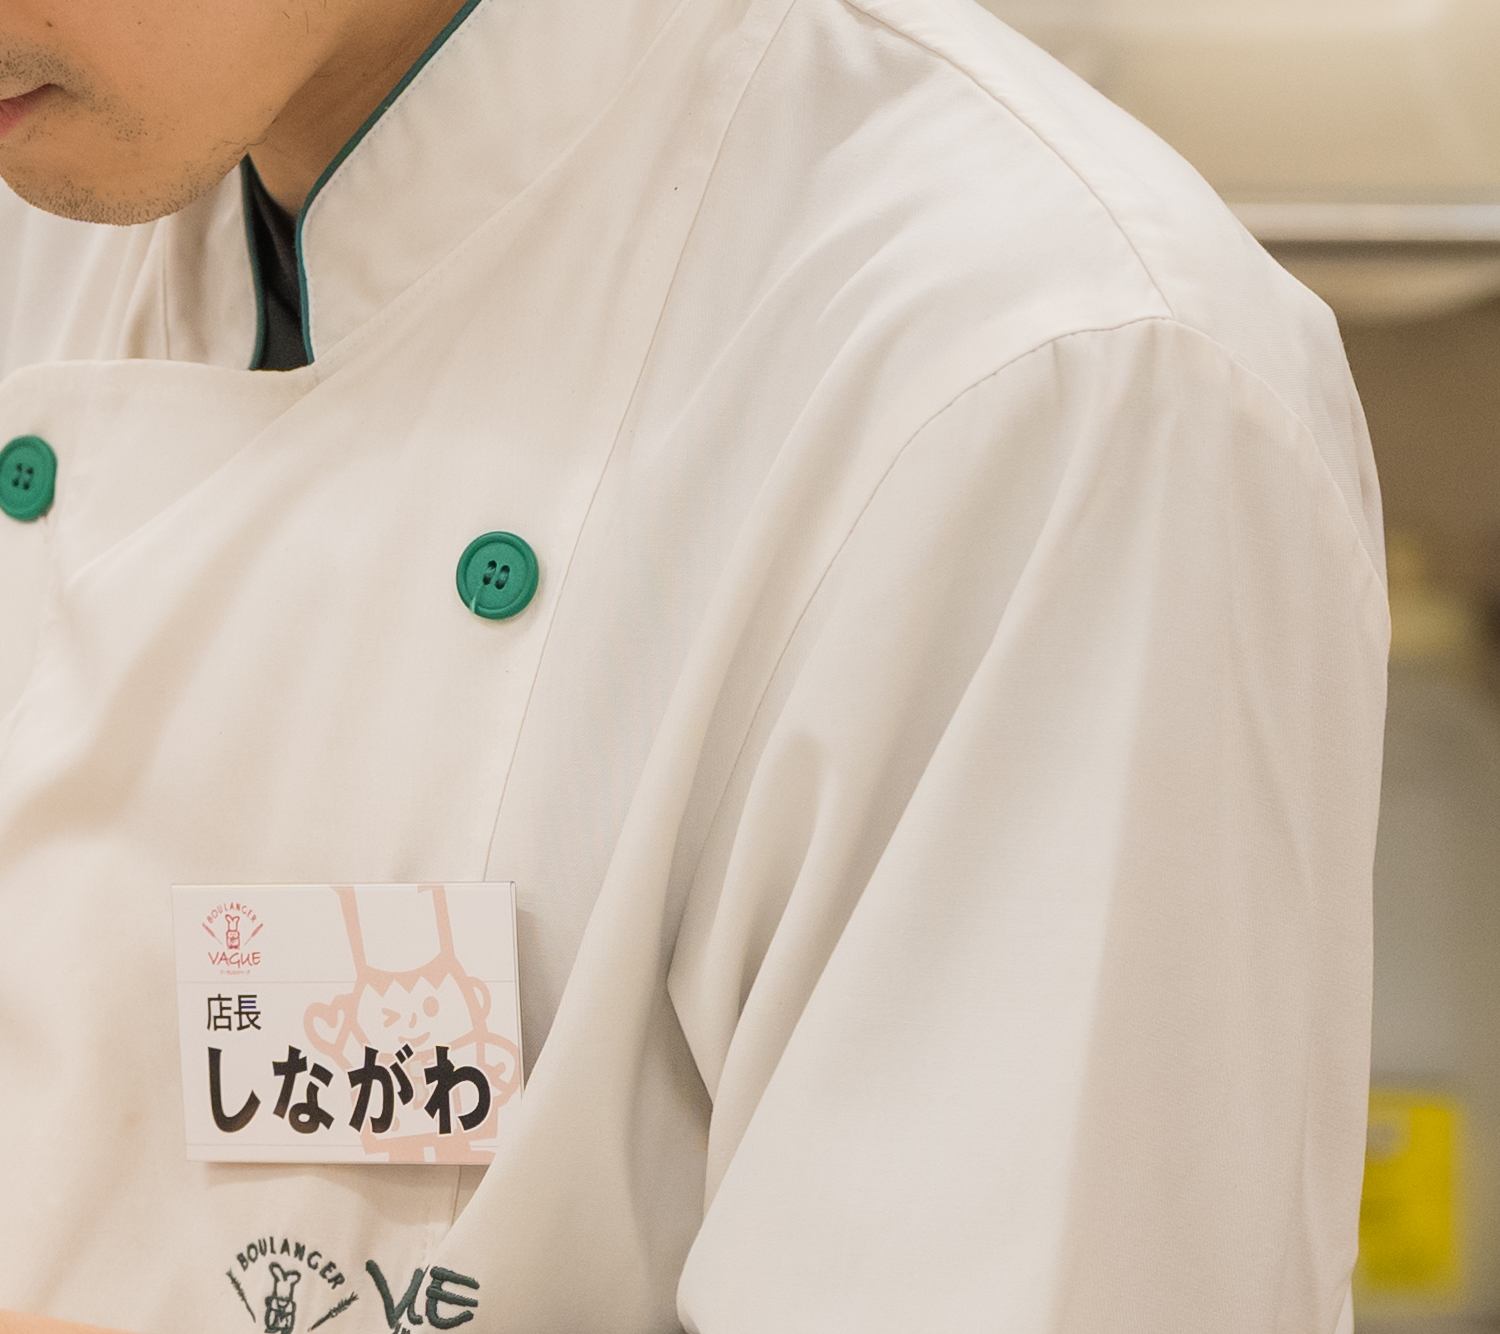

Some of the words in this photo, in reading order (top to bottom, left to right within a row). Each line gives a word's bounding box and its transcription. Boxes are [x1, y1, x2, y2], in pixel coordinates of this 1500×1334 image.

[206, 902, 257, 924] BOULANGER
[207, 951, 261, 968] VAGUE
[207, 993, 262, 1031] 店長
[207, 1043, 492, 1135] しながわ
[236, 1236, 346, 1290] BOULANGER
